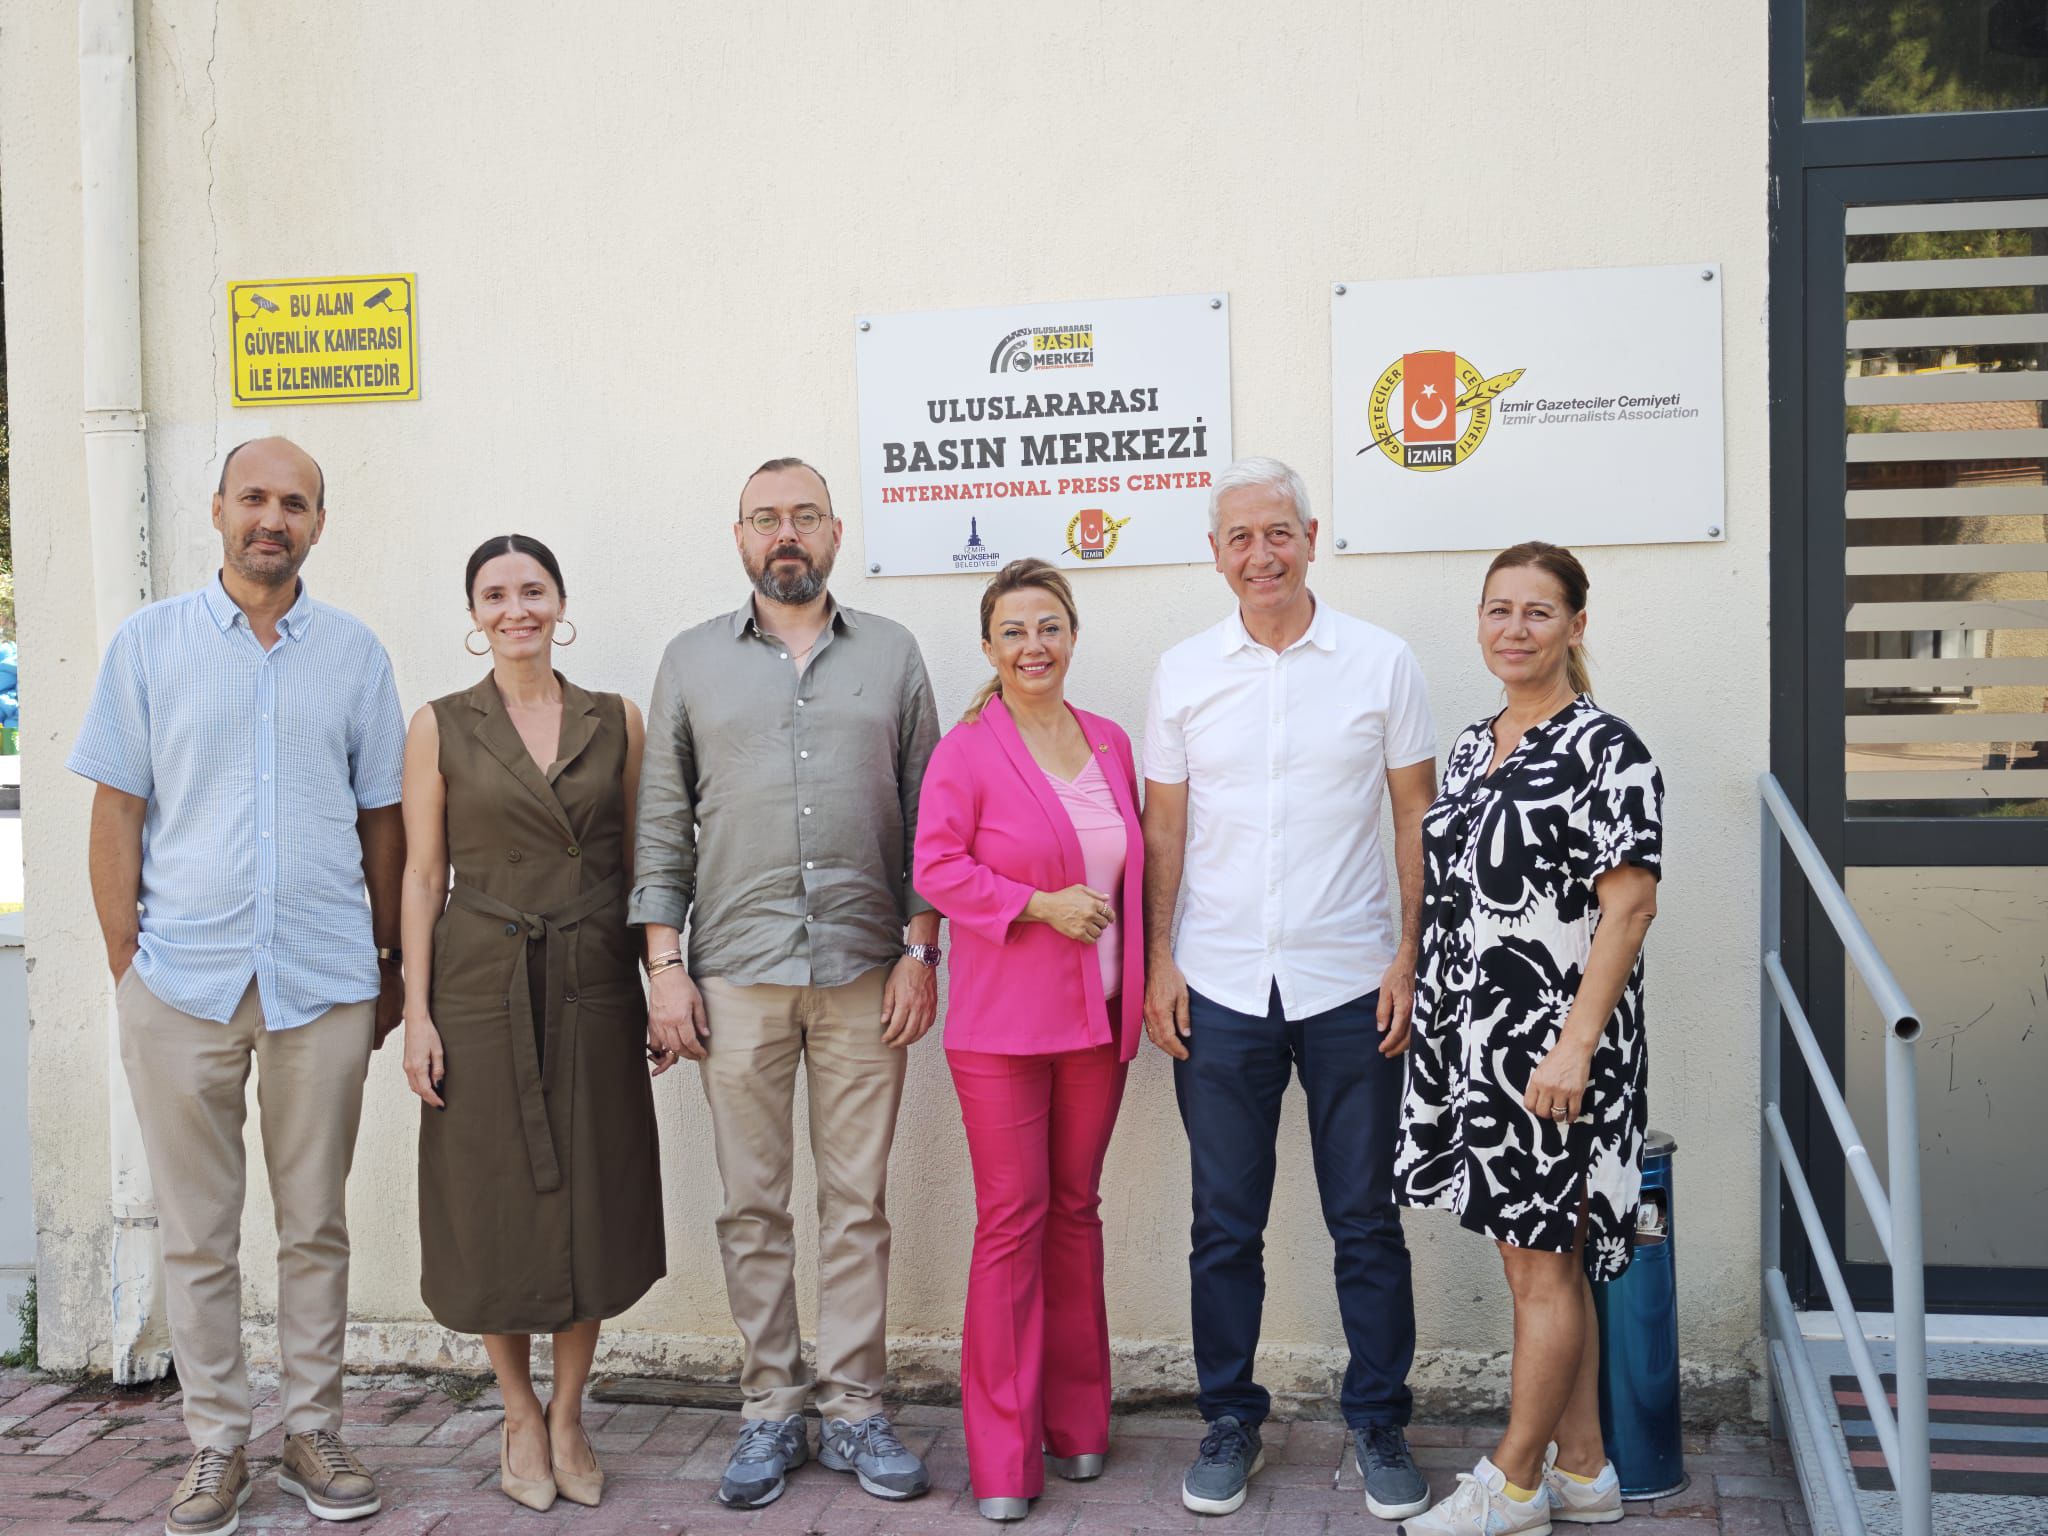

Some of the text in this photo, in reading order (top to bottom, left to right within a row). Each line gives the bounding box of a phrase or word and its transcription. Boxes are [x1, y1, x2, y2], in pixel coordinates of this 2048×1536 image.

[290, 294, 310, 317] BU
[316, 292, 353, 315] ALAN
[1033, 324, 1092, 334] ULUSLARARASI
[245, 325, 401, 356] GÜVENLİK KAMERASI
[1033, 333, 1093, 351] BASIN
[1033, 348, 1094, 366] MERKEZİ
[250, 358, 400, 391] İLE İZLENMEKTEDİR
[928, 388, 1159, 424] ULUSLARARASI
[1500, 393, 1680, 412] İzmir Gazeteciler Cemiyeti
[1538, 409, 1616, 424] Journalists
[1618, 407, 1699, 421] Association
[883, 416, 1207, 473] BASIN MERKEZİ
[1407, 447, 1452, 464] İZMİR
[882, 471, 1212, 503] INTERNATIONAL PRESS CENTER
[837, 1440, 855, 1459] N
